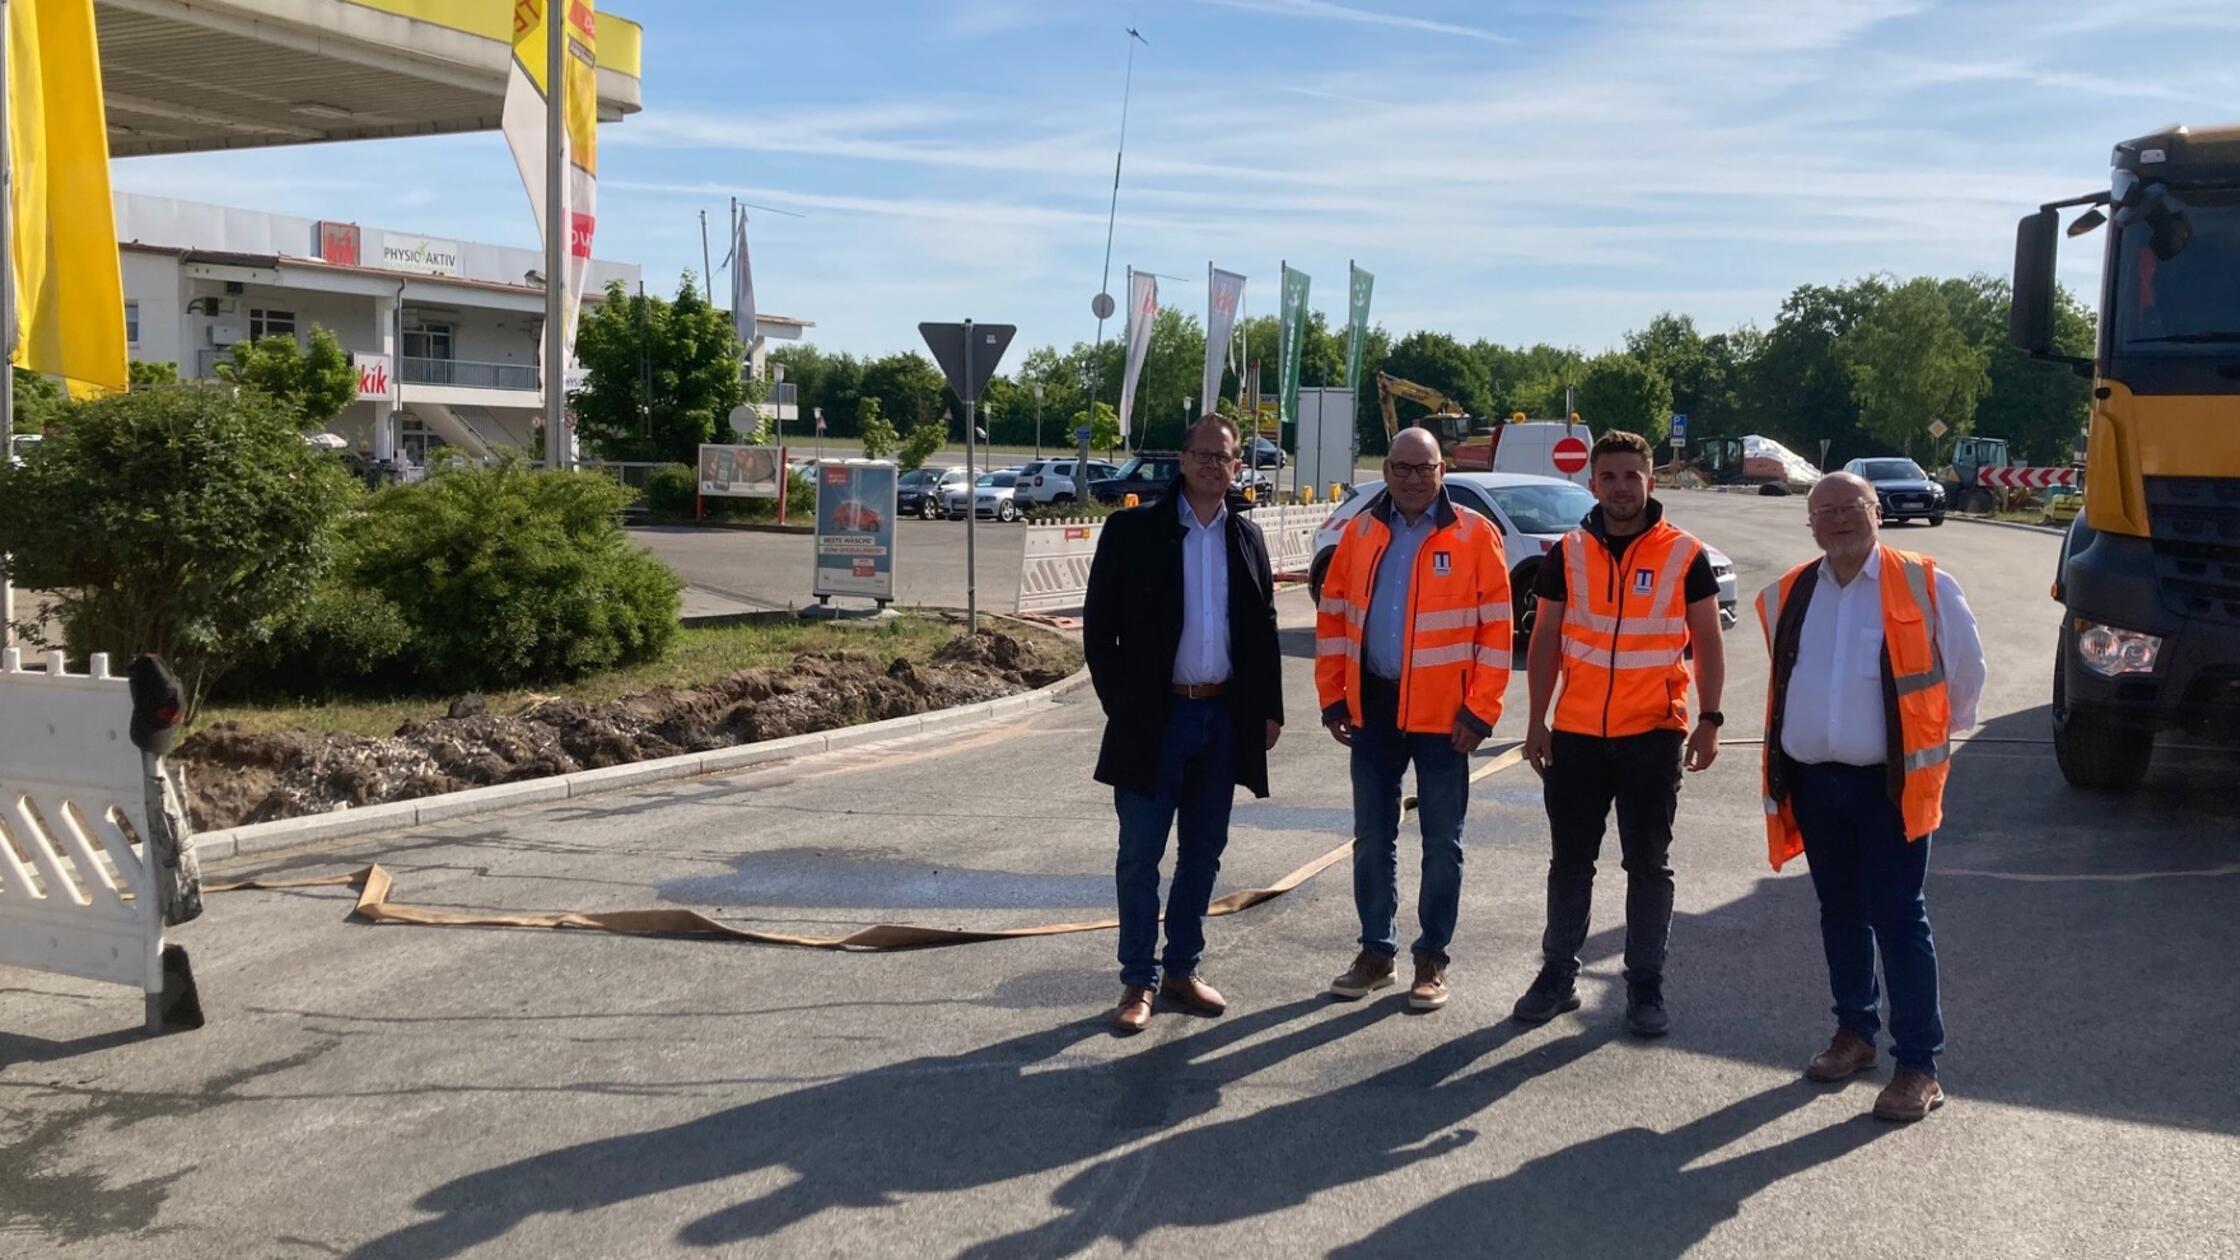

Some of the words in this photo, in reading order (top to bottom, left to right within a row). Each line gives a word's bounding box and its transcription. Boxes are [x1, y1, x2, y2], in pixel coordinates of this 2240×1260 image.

[384, 247, 421, 263] PHYSIO
[426, 251, 456, 267] AKTIV
[359, 361, 387, 394] kik
